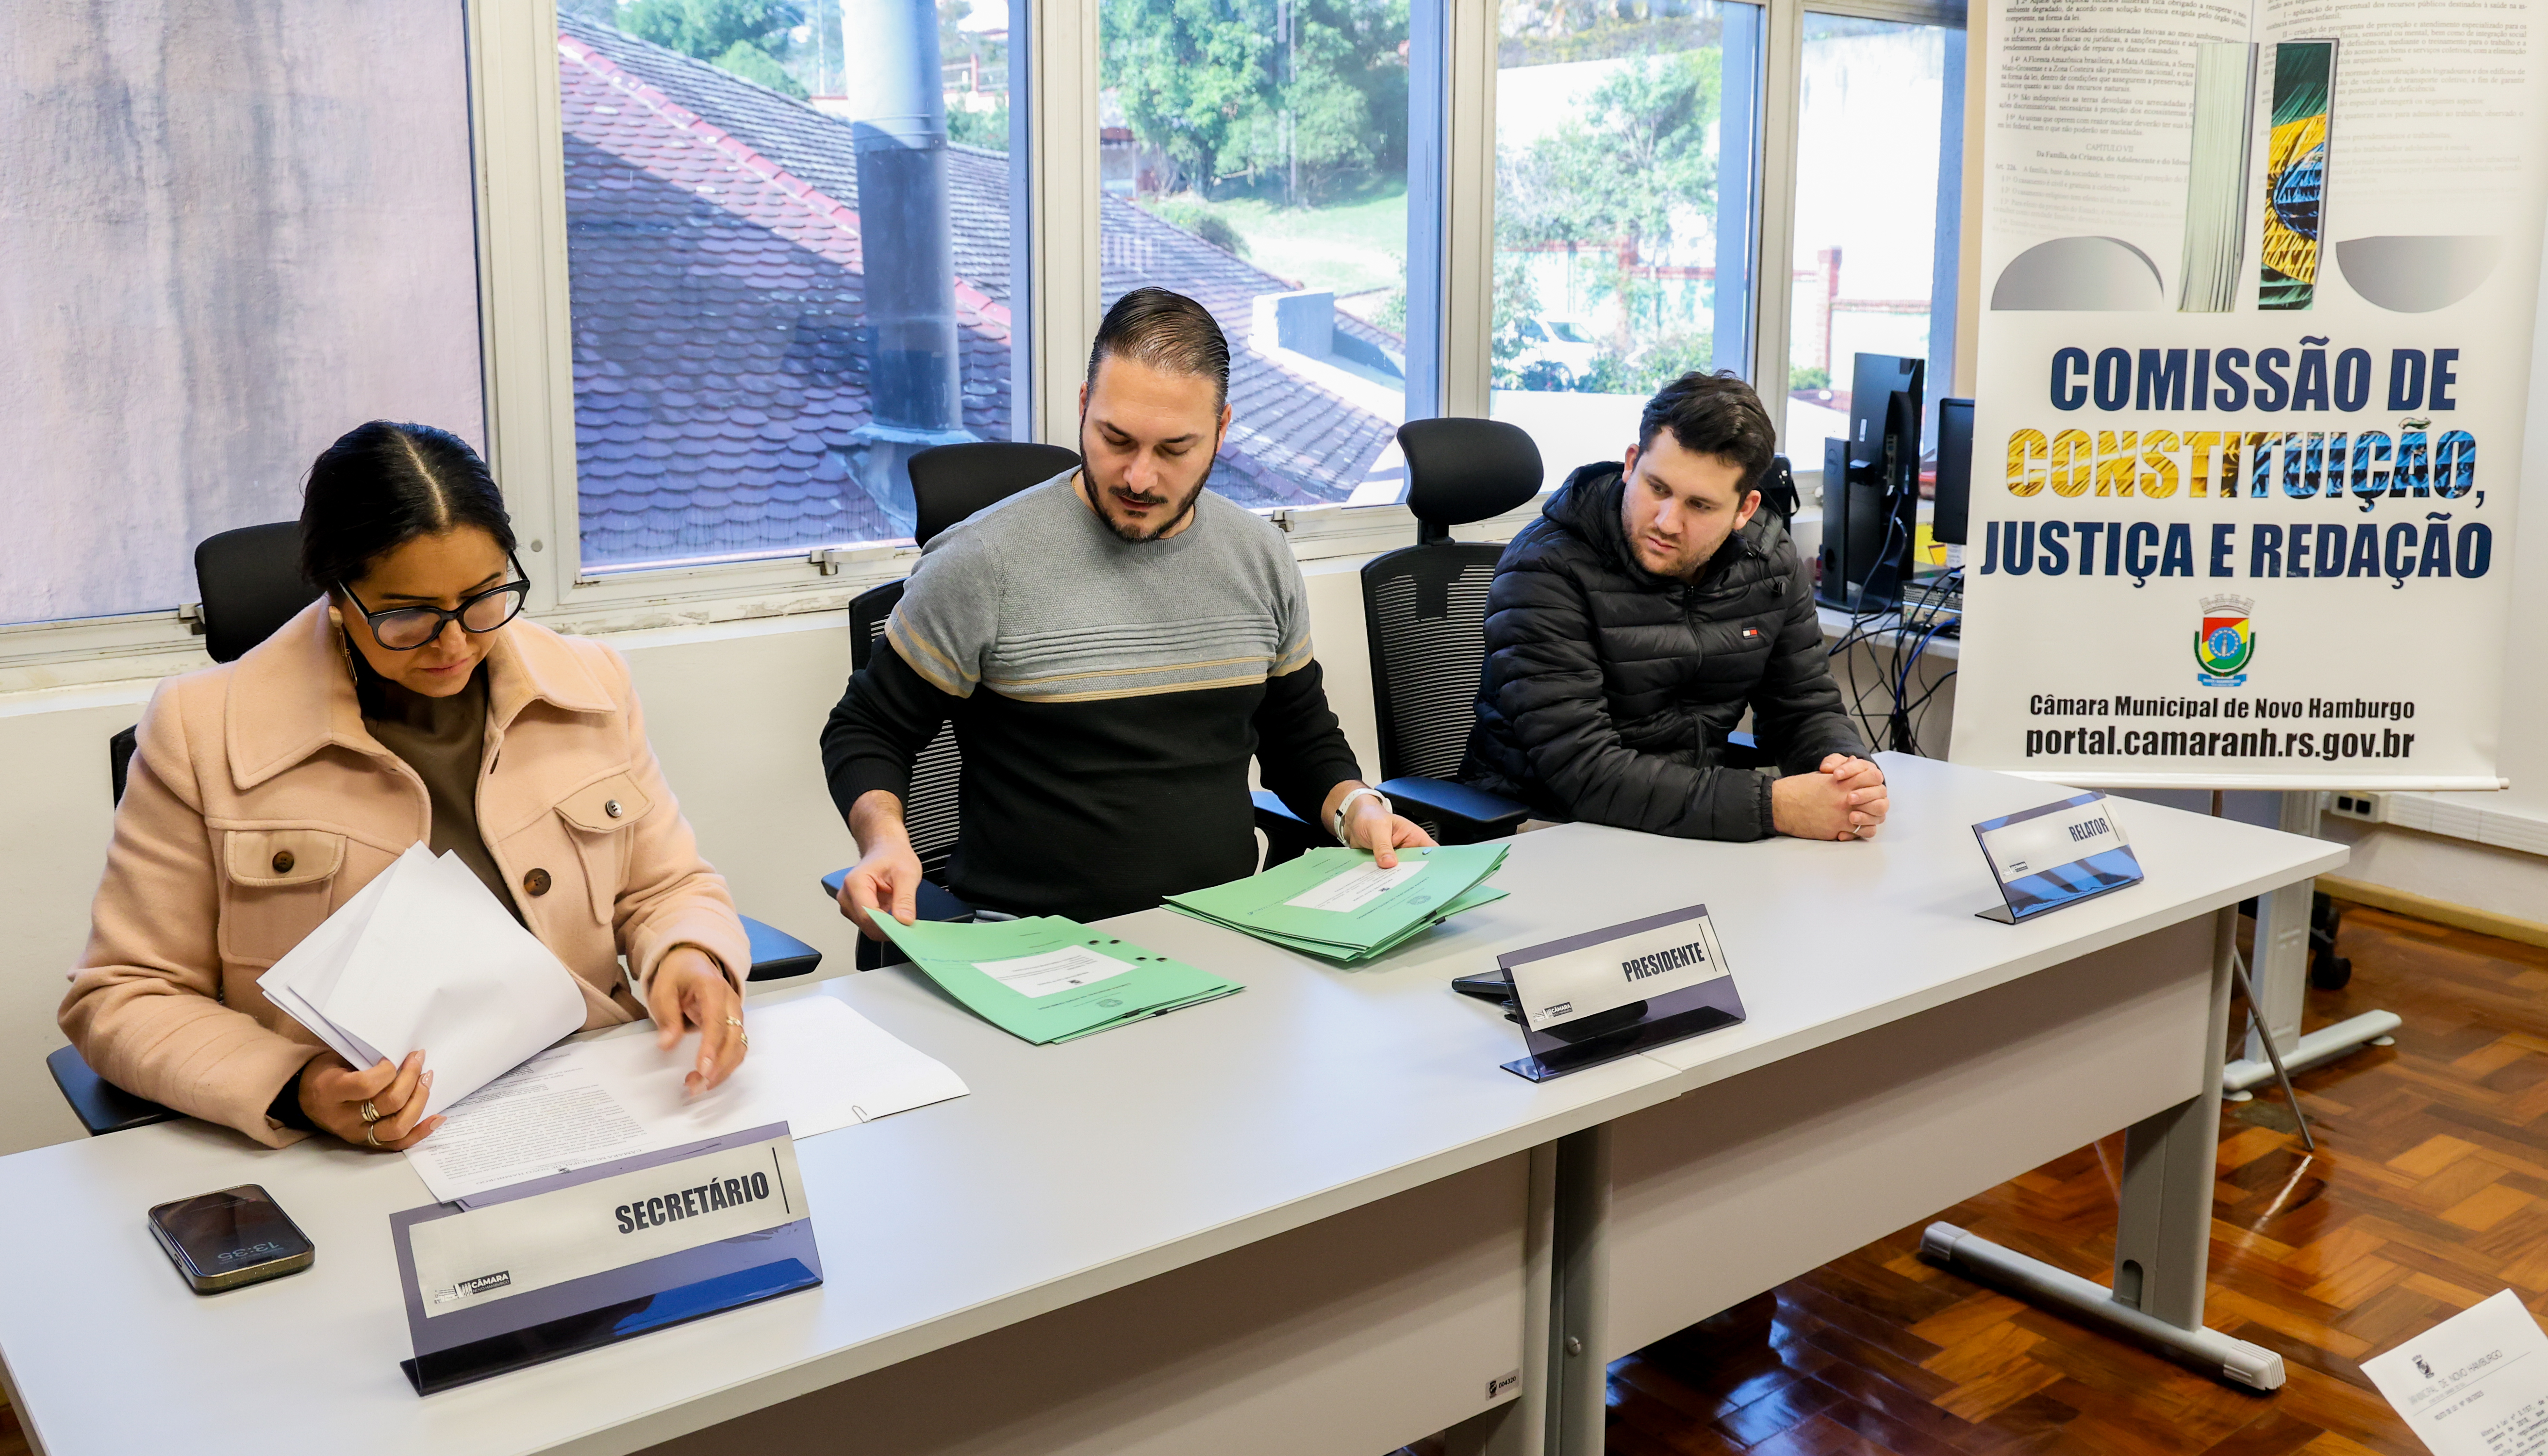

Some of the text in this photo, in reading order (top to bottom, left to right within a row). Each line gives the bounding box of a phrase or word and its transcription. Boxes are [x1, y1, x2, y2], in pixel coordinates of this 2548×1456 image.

[2051, 336, 2459, 412] COMISSÃO DE
[2005, 417, 2485, 513] CONSTITUIÇÃO,
[1980, 512, 2492, 589] JUSTIÇA E REDAÇÃO
[2031, 695, 2414, 721] Câmara Municipal de Novo Hamburgo
[2027, 725, 2414, 761] portal.camaranh.rs.gov.br
[2069, 818, 2109, 842] RELATOR
[1622, 943, 1704, 982] PRESIDENTE
[1551, 1004, 1571, 1013] CÂMARA
[615, 1172, 770, 1234] SECRETÁRIO
[217, 1242, 279, 1261] 13:35
[471, 1273, 509, 1289] CÂMARA
[1499, 1376, 1516, 1389] 004320
